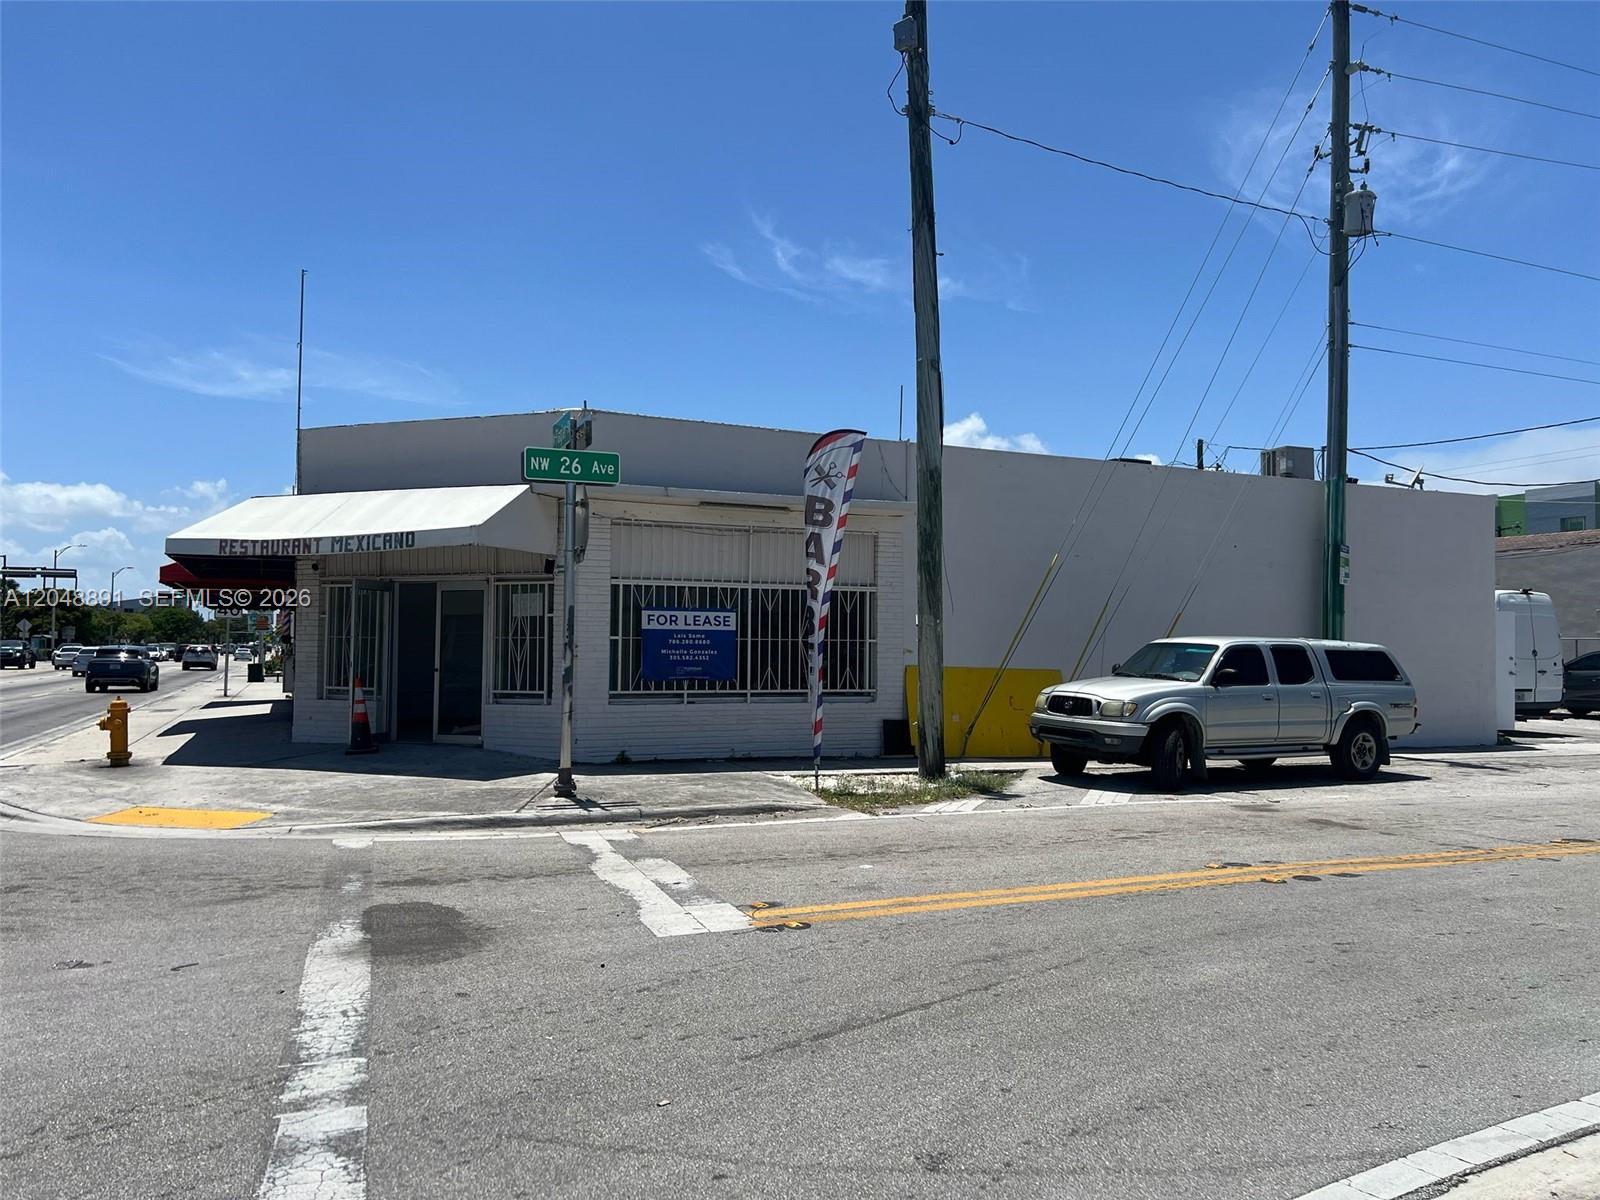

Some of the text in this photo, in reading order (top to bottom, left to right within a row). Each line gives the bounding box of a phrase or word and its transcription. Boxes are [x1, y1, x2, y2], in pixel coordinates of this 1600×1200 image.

[530, 456, 615, 475] NW 26 Ave
[218, 531, 416, 555] RESTAURANT MEXICANO
[804, 494, 836, 690] BARB
[647, 613, 731, 627] FOR LEASE
